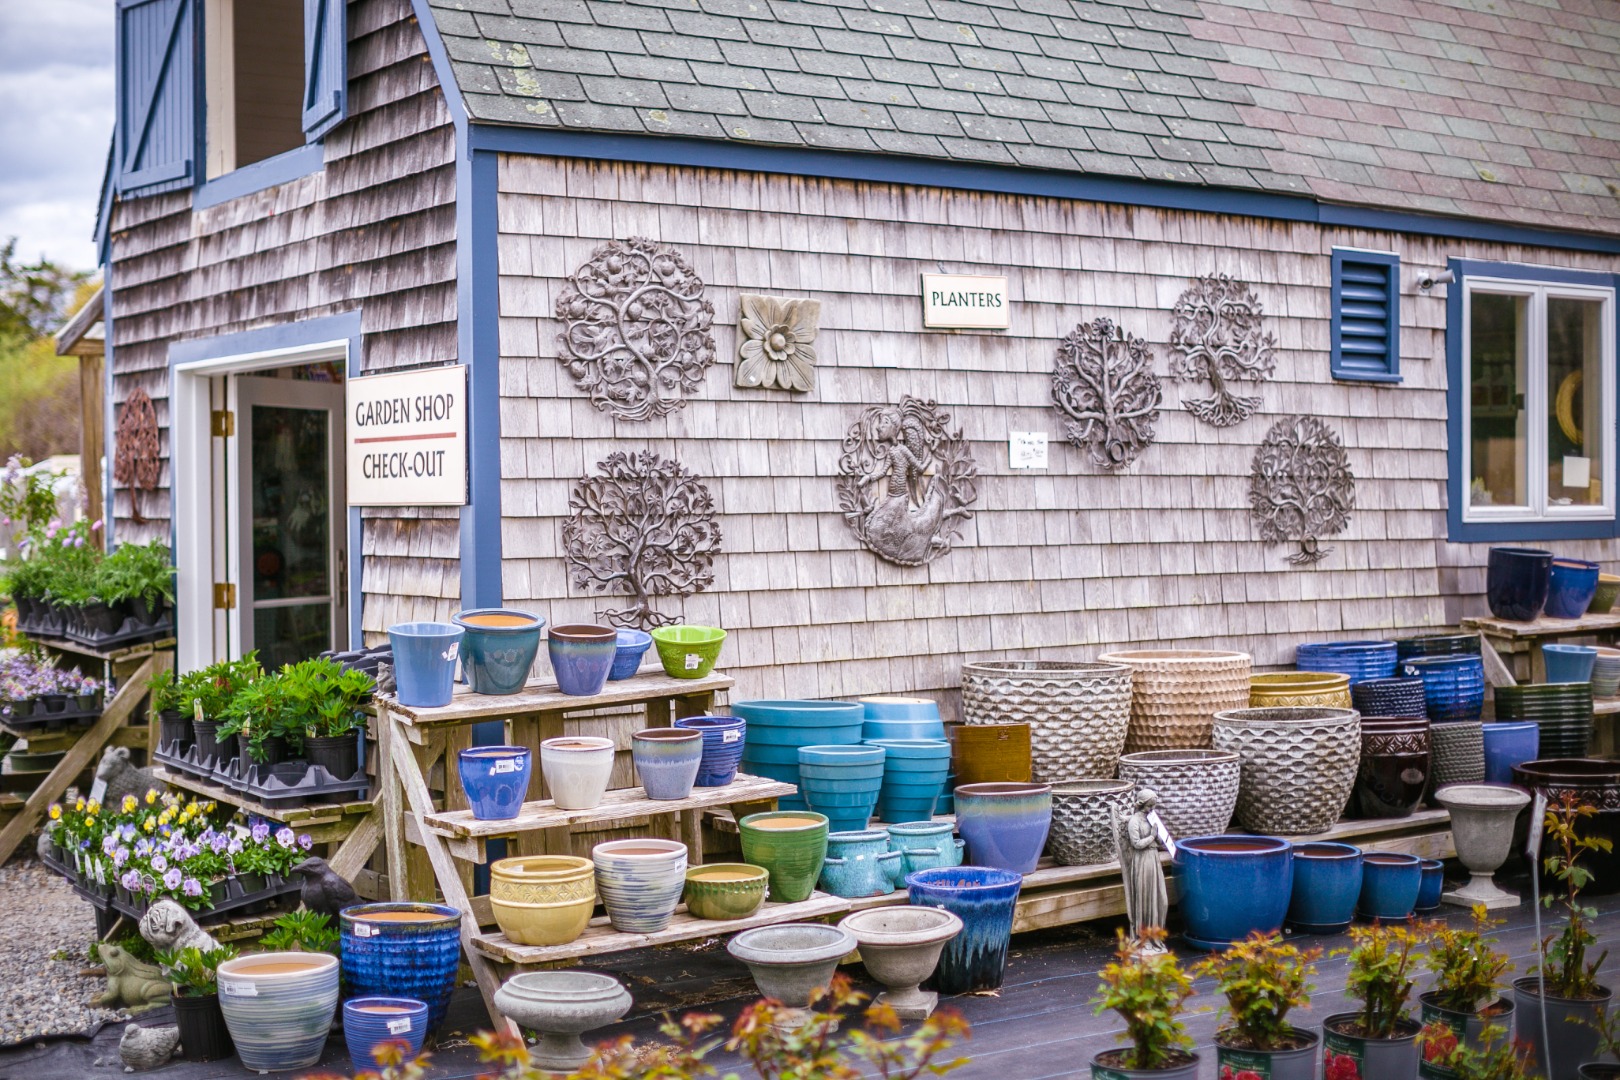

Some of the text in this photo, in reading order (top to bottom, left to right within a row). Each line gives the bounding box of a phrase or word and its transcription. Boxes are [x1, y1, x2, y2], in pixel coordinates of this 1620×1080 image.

[932, 291, 1002, 308] PLANTERS
[355, 393, 454, 427] GARDEN SHOP
[362, 450, 445, 479] CHECK-OUT
